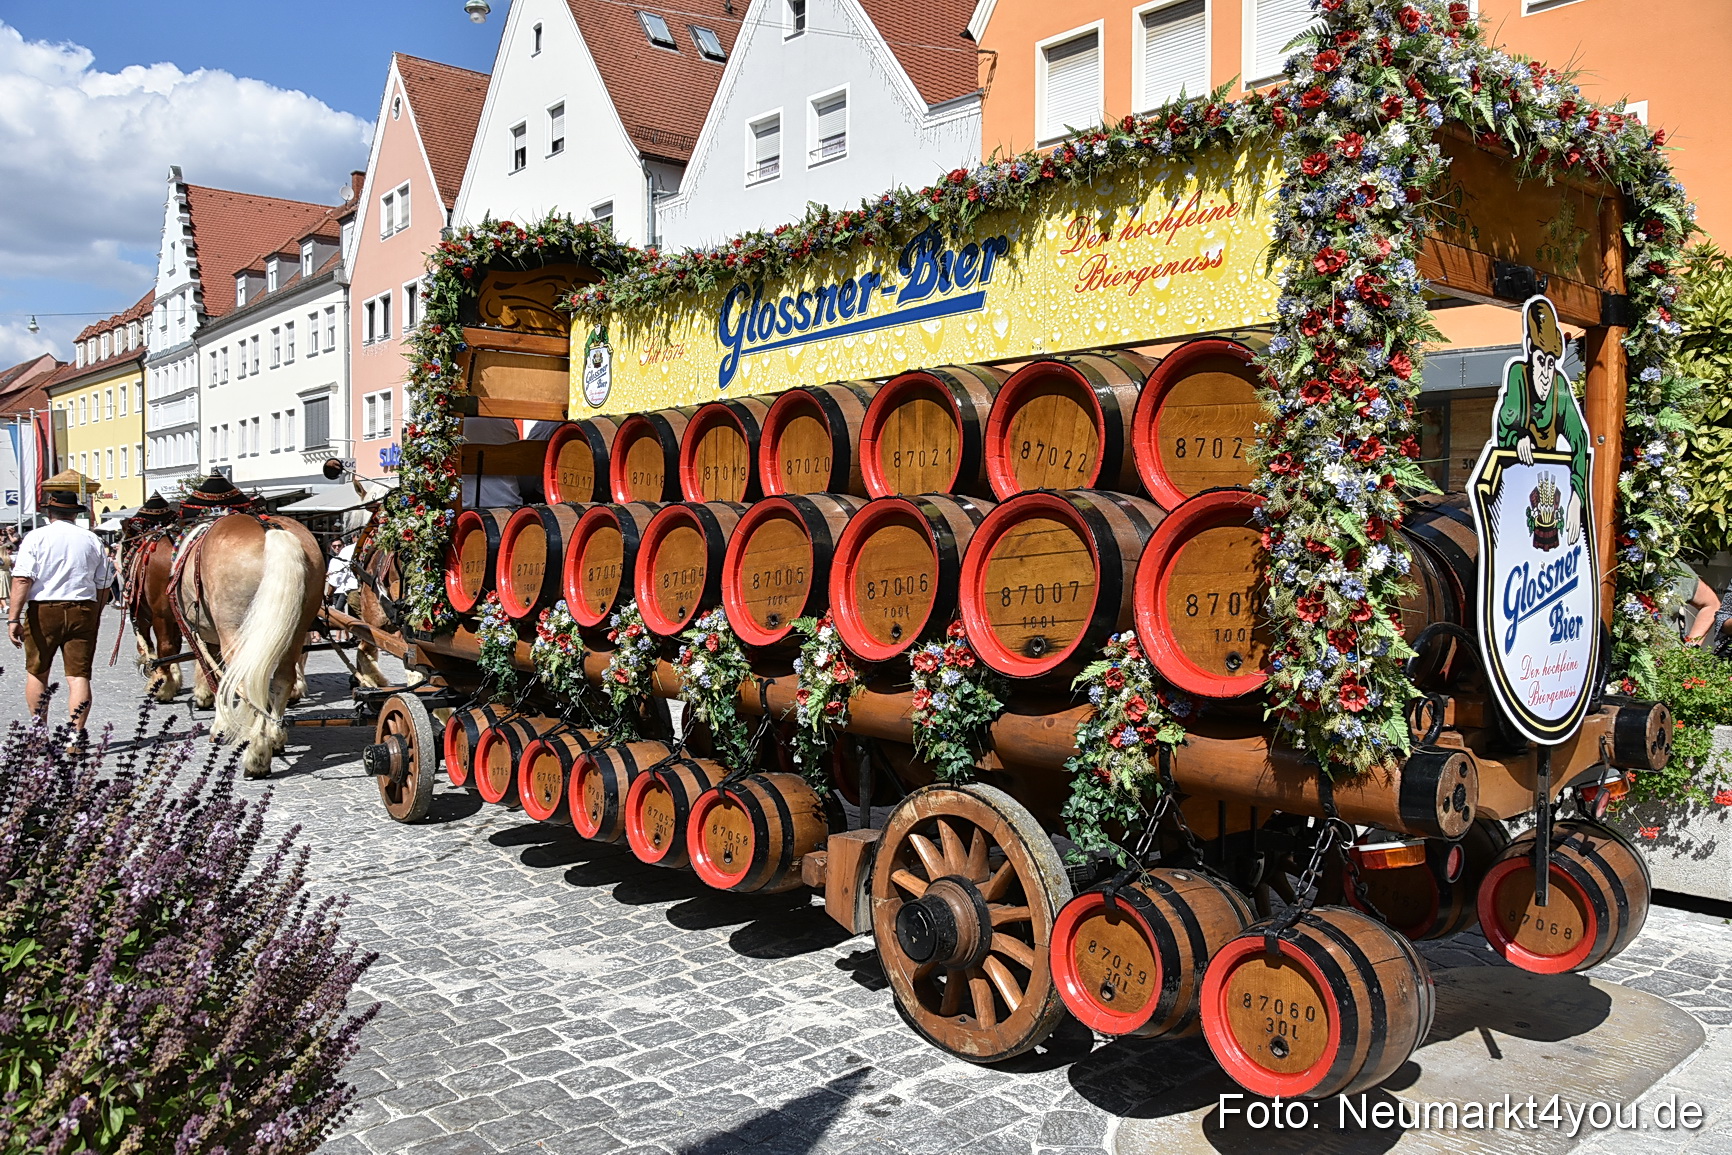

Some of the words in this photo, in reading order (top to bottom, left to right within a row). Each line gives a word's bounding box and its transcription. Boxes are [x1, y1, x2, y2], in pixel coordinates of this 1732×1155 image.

[1060, 215, 1111, 255] Der
[1119, 190, 1240, 245] hochfeine
[1074, 249, 1223, 296] Biergenuss
[719, 221, 1009, 390] Glossner-Bier
[661, 343, 685, 362] 1574
[894, 447, 951, 468] 87021
[1020, 441, 1086, 472] 87022
[1176, 437, 1242, 458] 8702
[705, 466, 747, 481] 87019
[787, 457, 830, 475] 87020
[563, 472, 592, 488] 87017
[633, 472, 664, 488] 87018
[663, 567, 704, 588] 87004
[753, 567, 803, 589] 87005
[868, 573, 928, 600] 87006
[1002, 581, 1079, 607] 87007
[1186, 592, 1261, 617] 8700
[1503, 545, 1582, 656] Glossner
[1549, 600, 1584, 645] Bier
[1520, 655, 1540, 681] Der
[1542, 650, 1579, 682] hochfeine
[1528, 680, 1577, 711] Biergenuss
[648, 806, 674, 828] 87057
[712, 824, 748, 846] 87058
[1508, 910, 1573, 940] 87068
[1088, 940, 1147, 985] 87059
[1243, 993, 1315, 1022] 87060
